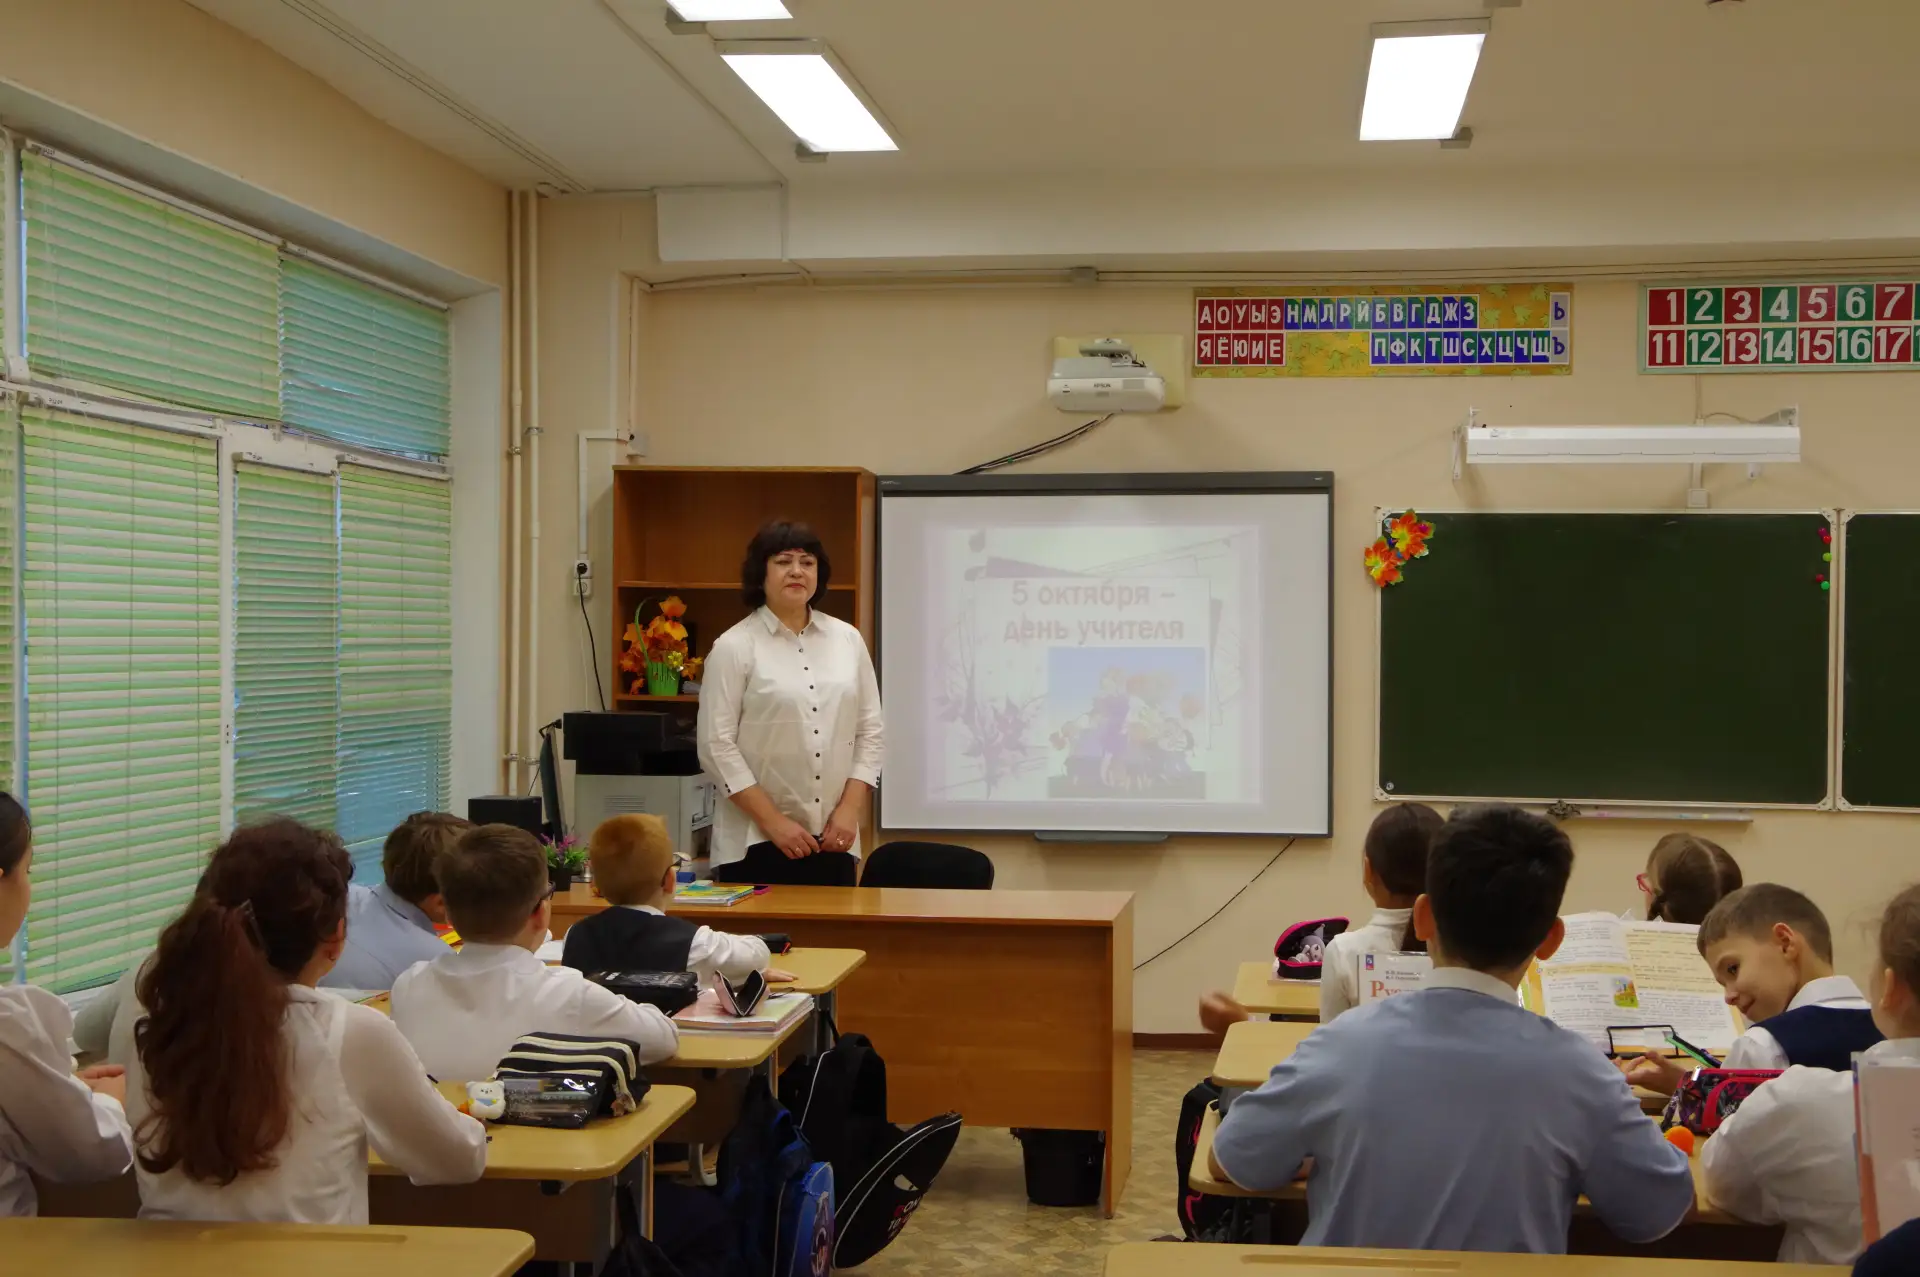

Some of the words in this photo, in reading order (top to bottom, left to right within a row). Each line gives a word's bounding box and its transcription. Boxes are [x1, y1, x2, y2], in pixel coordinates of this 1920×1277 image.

[1553, 301, 1565, 320] Ь
[1666, 292, 1677, 322] 1
[1694, 290, 1714, 321] 2
[1732, 291, 1752, 321] 3
[1769, 288, 1790, 320] 4
[1807, 287, 1828, 319] 5
[1845, 287, 1866, 319] 6
[1883, 286, 1906, 318] 7
[1652, 332, 1677, 364] 11
[1688, 331, 1720, 363] 12
[1725, 331, 1757, 362] 13
[1763, 330, 1794, 361] 14
[1800, 330, 1834, 361] 15
[1838, 329, 1871, 360] 16
[1876, 328, 1911, 359] 17
[1011, 580, 1029, 606] 5
[1038, 579, 1150, 612] октября
[1003, 618, 1069, 643] день
[1077, 619, 1184, 645] учителя
